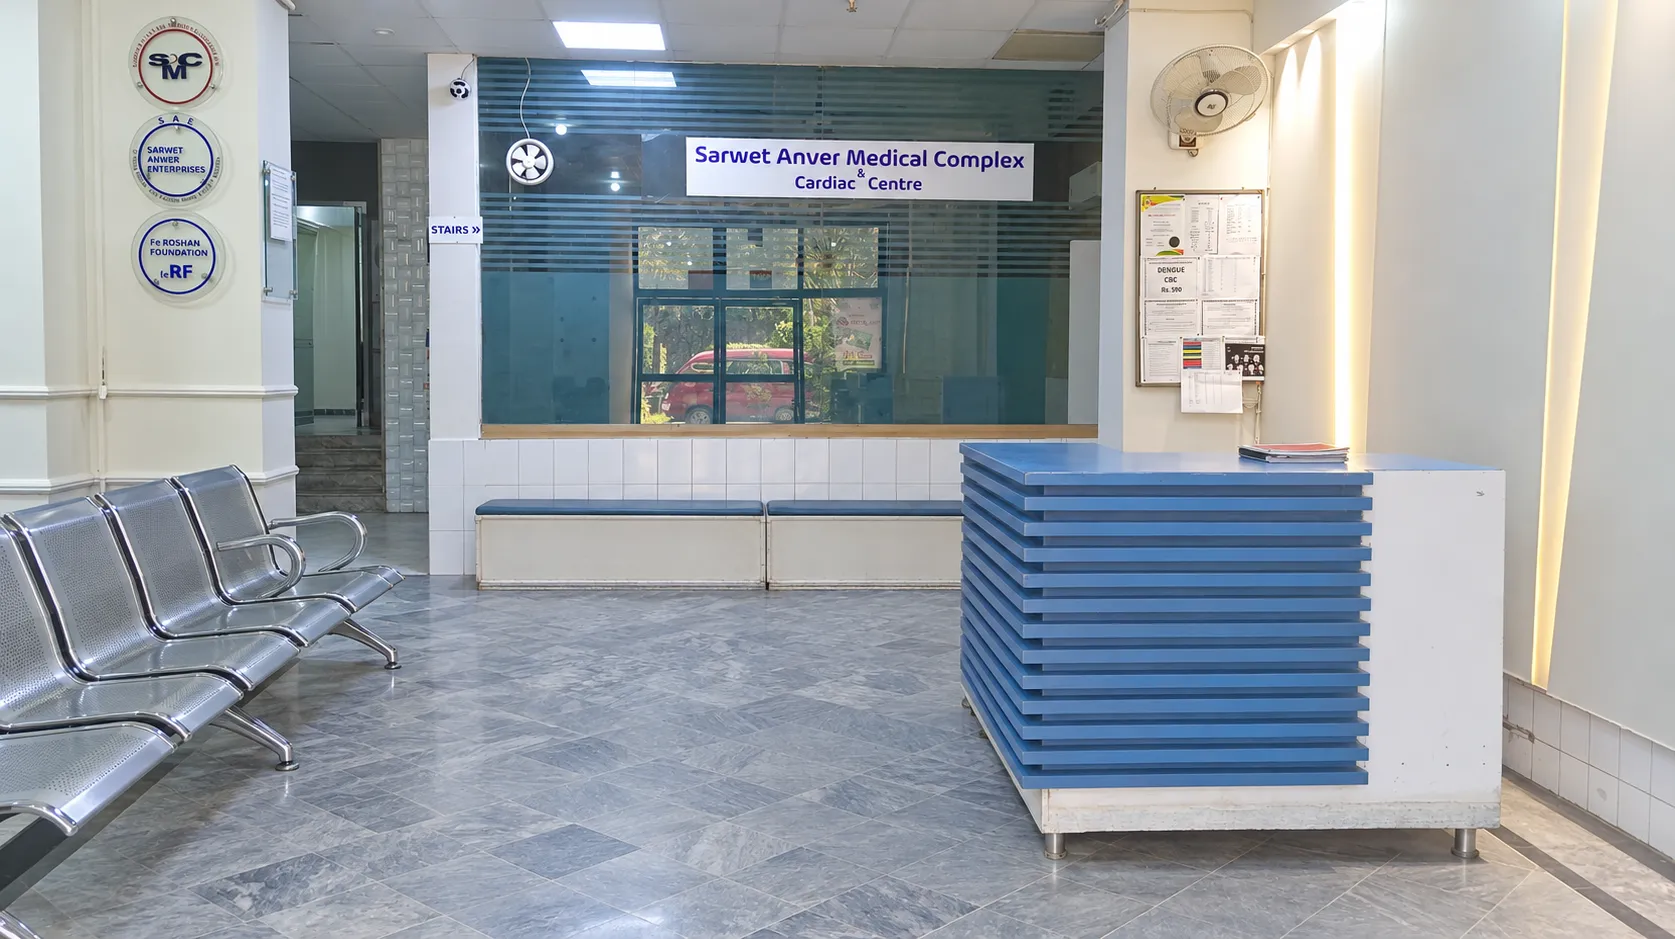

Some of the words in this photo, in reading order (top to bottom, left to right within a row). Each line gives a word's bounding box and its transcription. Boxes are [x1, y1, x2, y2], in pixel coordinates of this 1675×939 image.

[147, 146, 184, 154] SARWET
[147, 155, 180, 164] ANWER
[695, 145, 771, 164] Sarwet
[776, 148, 841, 166] Anver
[846, 149, 928, 167] Medical
[933, 150, 1025, 172] Complex
[147, 165, 206, 174] ENTERPRISES
[857, 168, 866, 178] &
[795, 175, 856, 190] Cardiac
[868, 177, 923, 191] Centre
[431, 225, 469, 235] STAIRS
[150, 238, 161, 247] Fe
[162, 239, 201, 247] ROSHAN
[150, 248, 208, 257] FOUNDATION
[1157, 266, 1186, 274] DENGUE
